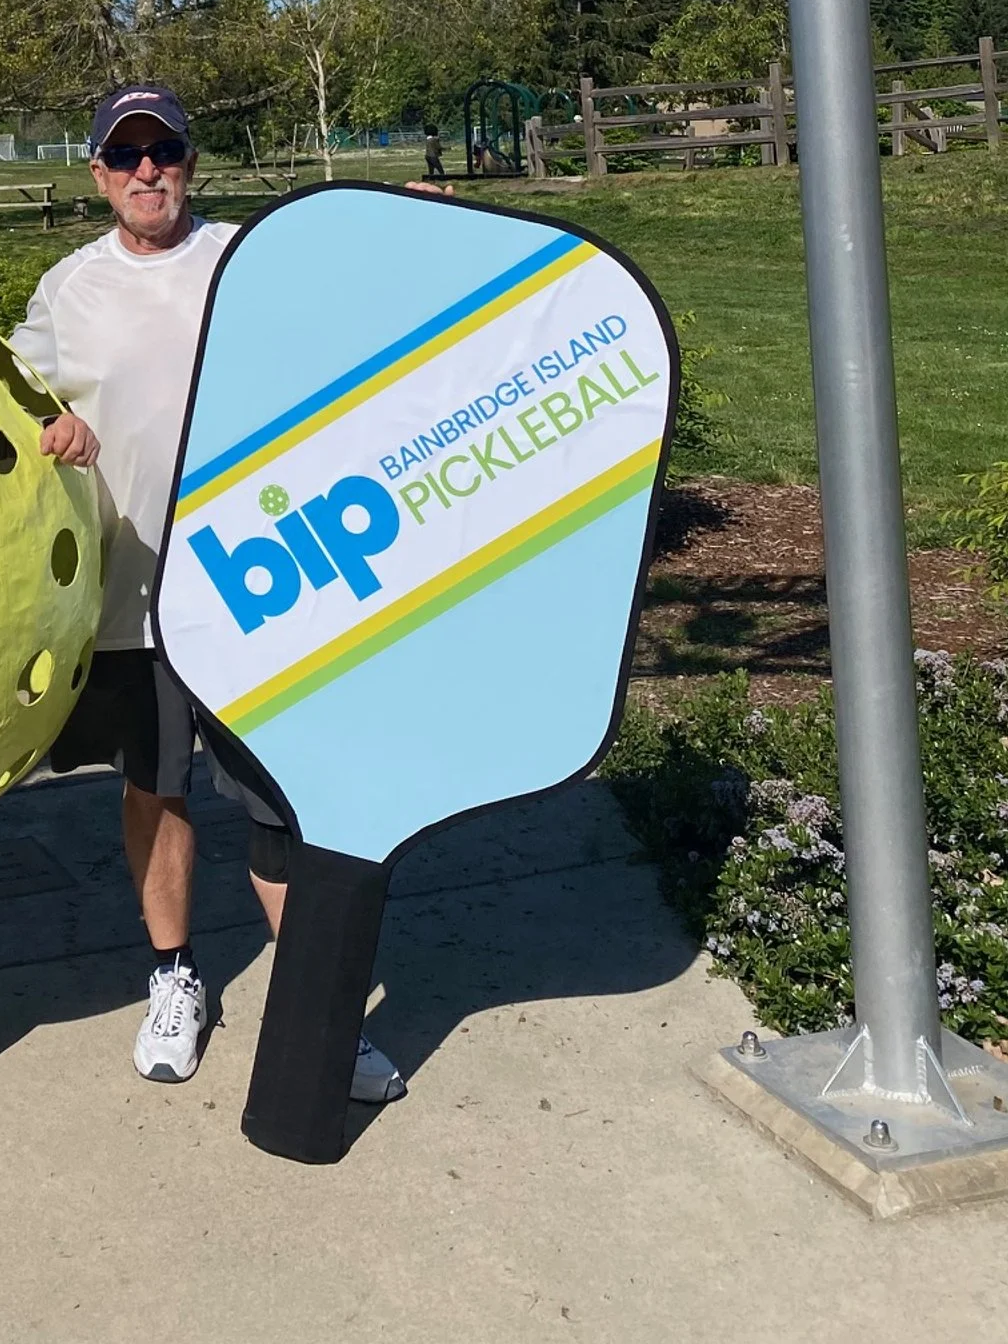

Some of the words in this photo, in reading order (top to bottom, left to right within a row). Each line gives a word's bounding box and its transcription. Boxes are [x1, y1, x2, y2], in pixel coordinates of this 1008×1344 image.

[379, 372, 535, 481] BAINBRIDGE
[532, 314, 627, 385] ISLAND
[398, 350, 659, 525] PICKLEBALL
[187, 475, 400, 635] bip
